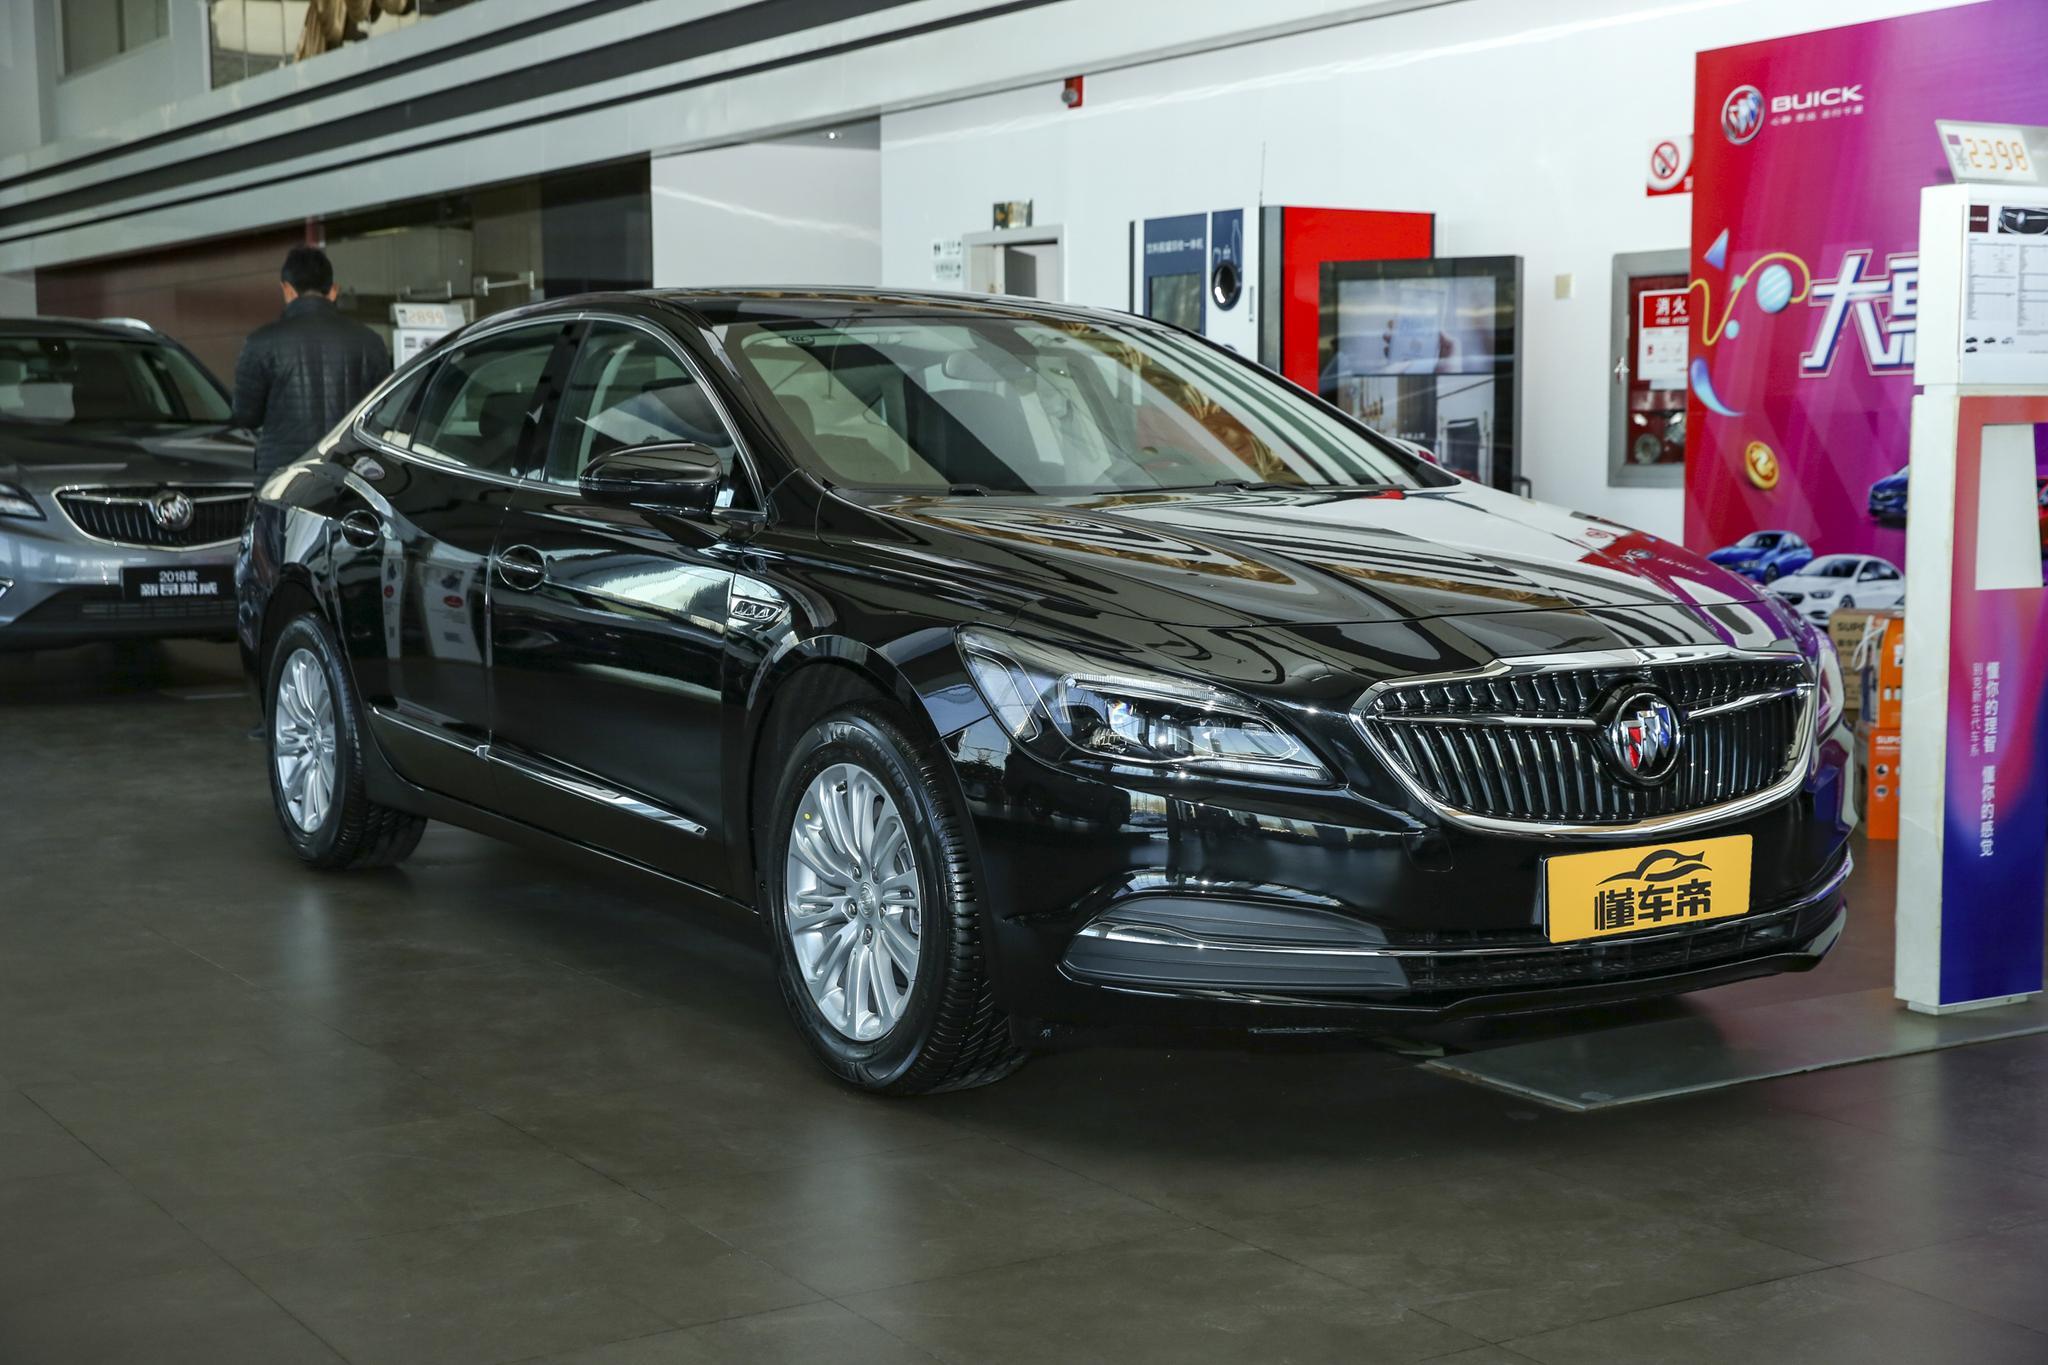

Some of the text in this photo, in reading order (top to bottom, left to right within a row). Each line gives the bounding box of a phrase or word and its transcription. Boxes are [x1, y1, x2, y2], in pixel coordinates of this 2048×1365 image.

[1771, 84, 1864, 113] BUICK
[1980, 661, 2000, 857] 懂你的理智 懂你的感觉
[1594, 878, 1712, 931] 懂车帝
